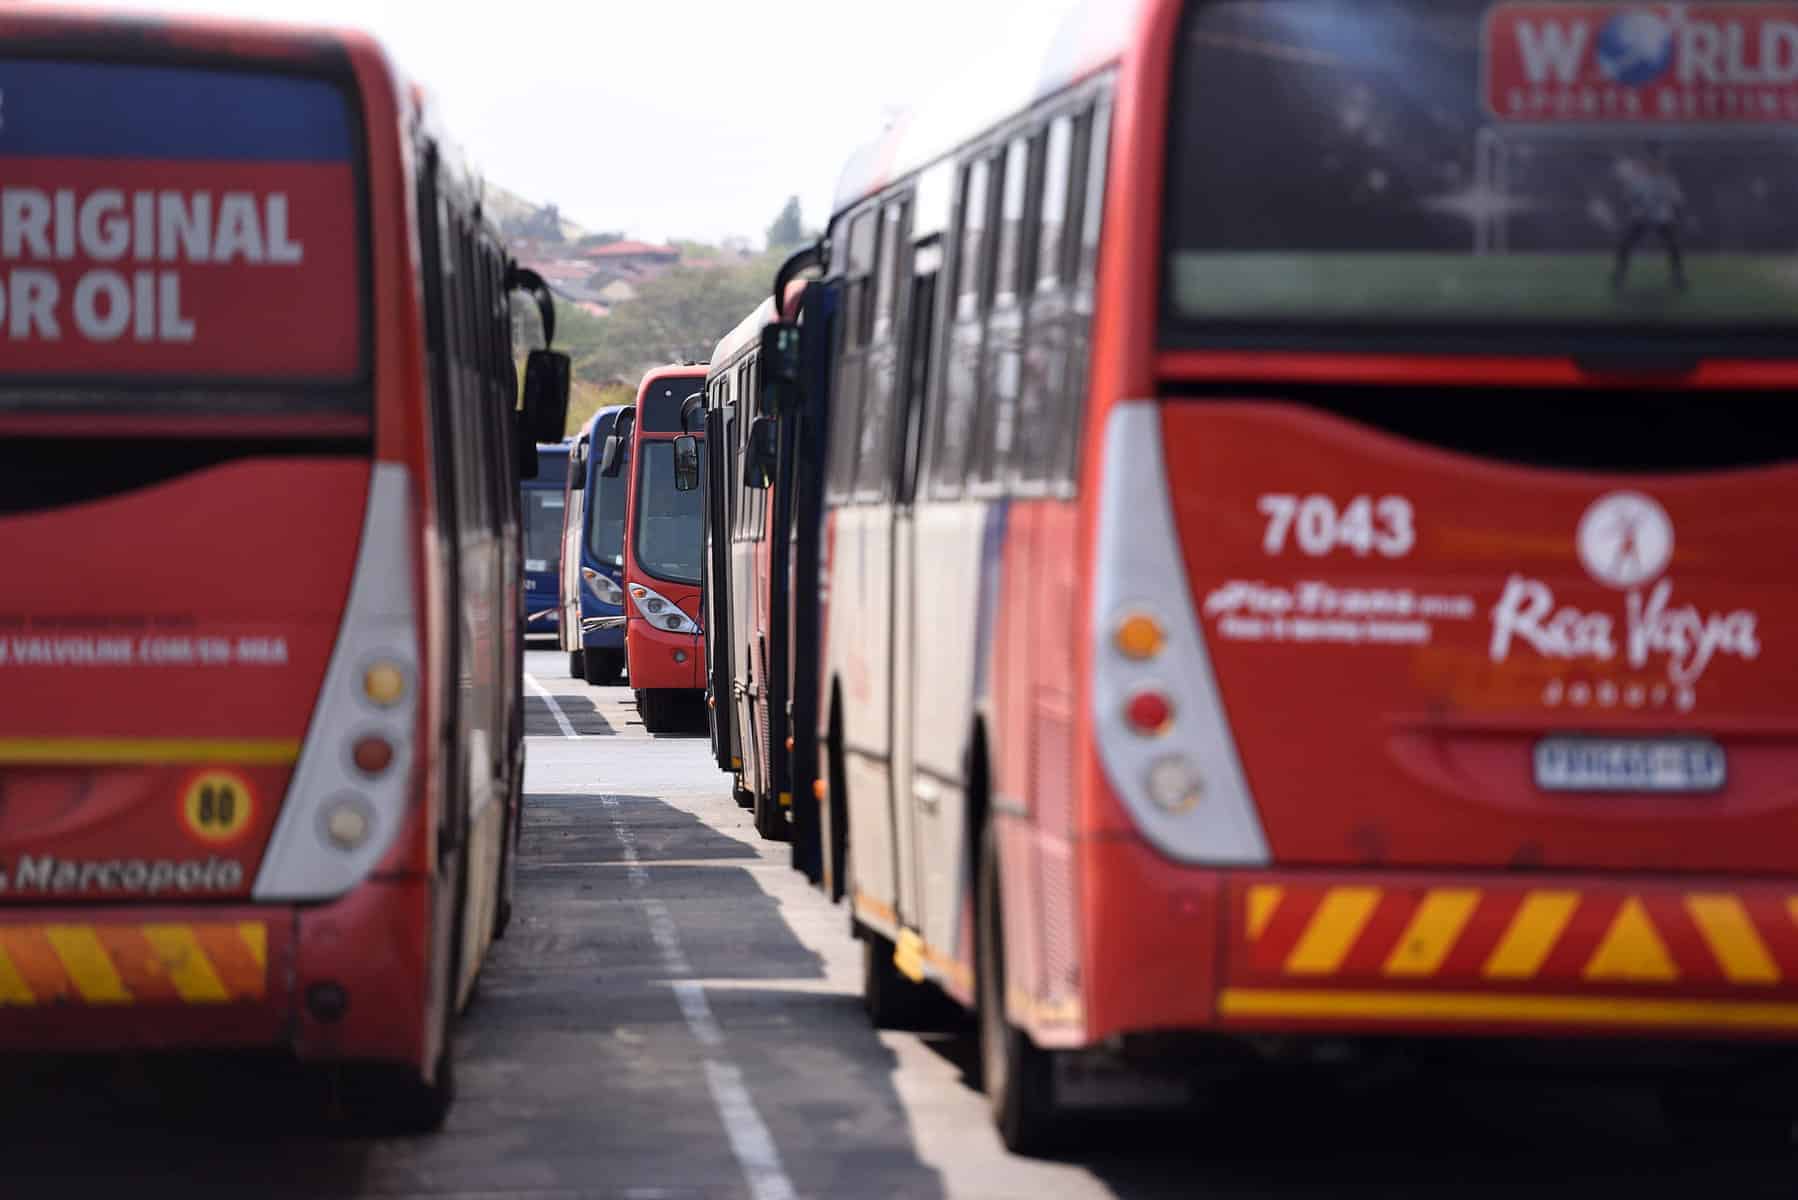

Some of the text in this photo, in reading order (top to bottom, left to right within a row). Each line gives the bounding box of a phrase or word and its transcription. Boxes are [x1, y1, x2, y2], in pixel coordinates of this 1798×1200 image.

[0, 268, 196, 344] R OIL
[1256, 493, 1416, 557] 7043
[1489, 574, 1761, 688] Rea Vaya
[198, 783, 237, 829] 80
[15, 852, 243, 895] Marcopolo
